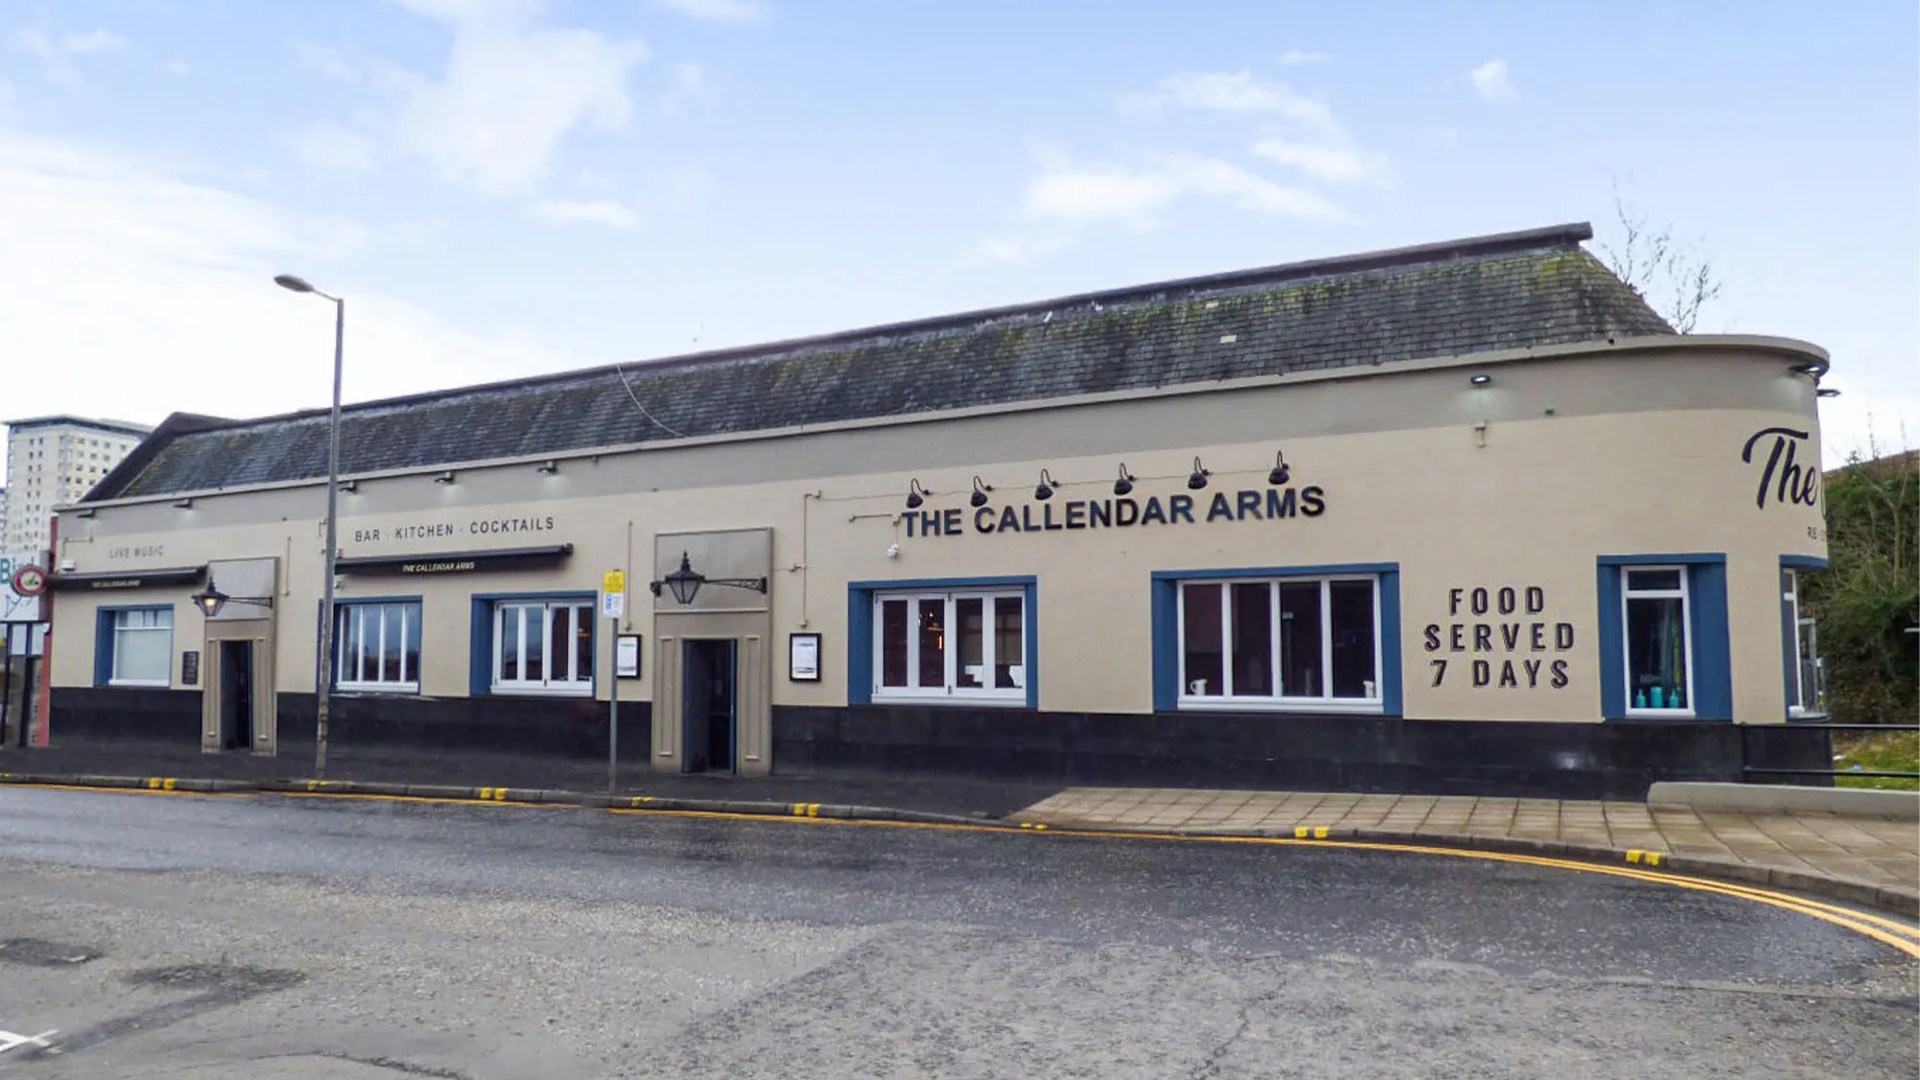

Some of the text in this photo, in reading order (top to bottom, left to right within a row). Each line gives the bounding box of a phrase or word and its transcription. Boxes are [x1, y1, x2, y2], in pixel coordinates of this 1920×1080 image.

[1742, 427, 1818, 510] The
[901, 486, 1325, 538] THE CALLENDAR ARMS
[355, 516, 554, 542] BAR KITCHEN COCKTAILS
[109, 545, 164, 559] LIVE MUSIC
[1449, 586, 1544, 616] FOOD
[1423, 623, 1574, 652] SERVED
[1430, 659, 1569, 689] 7 DAYS
